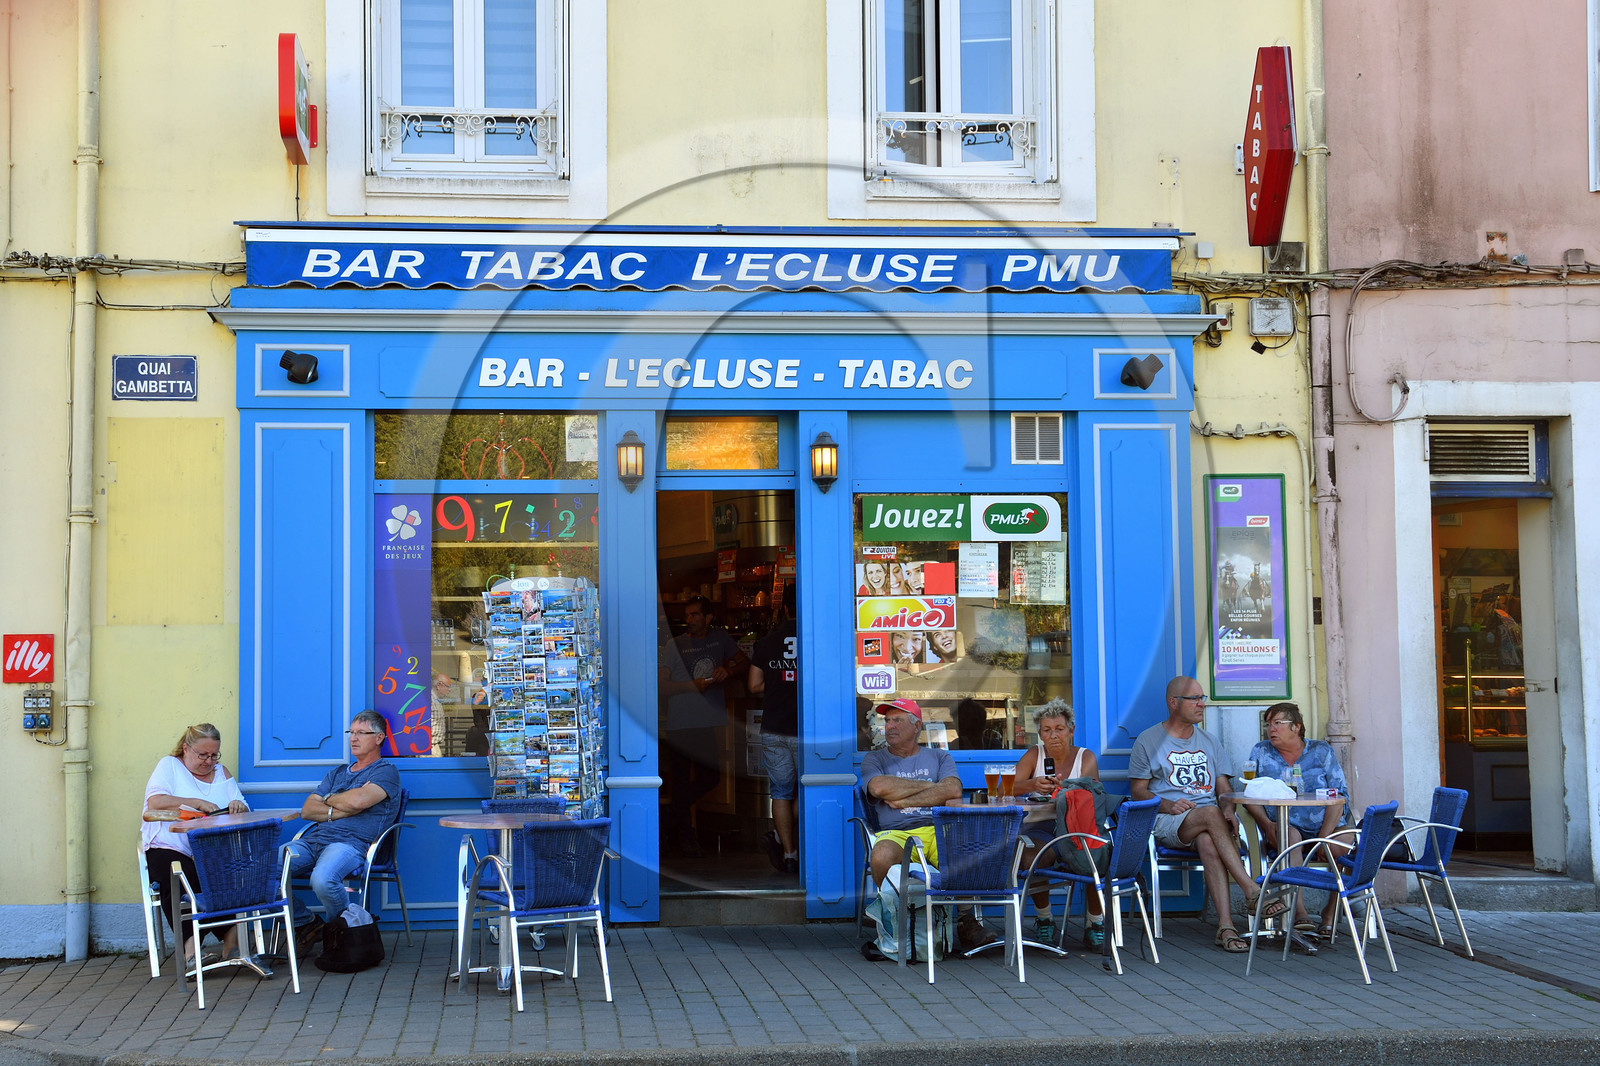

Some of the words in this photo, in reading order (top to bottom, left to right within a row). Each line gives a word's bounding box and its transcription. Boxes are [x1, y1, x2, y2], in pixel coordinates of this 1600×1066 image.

[1250, 84, 1262, 211] TABAC
[302, 249, 425, 279] BAR
[460, 251, 647, 281] TABAC
[691, 252, 957, 283] L'ECLUSE
[1001, 254, 1121, 283] PMU
[138, 362, 171, 375] QUAI
[479, 358, 564, 388] BAR
[605, 358, 800, 389] L'ECLUSE
[838, 359, 974, 389] TABAC
[116, 380, 193, 393] GAMBETTA
[494, 500, 513, 534] 7
[558, 510, 576, 538] 2
[869, 503, 965, 529] Jouez!
[990, 513, 1018, 525] PMU
[382, 545, 425, 553] FRANÇAISE
[5, 640, 51, 678] illy
[392, 645, 402, 658] 9
[1221, 645, 1232, 653] 10
[1233, 645, 1270, 653] MILLIONS
[407, 656, 419, 675] 2
[378, 666, 400, 695] 5
[398, 683, 427, 715] 7
[405, 706, 432, 754] 3
[1175, 755, 1196, 764] HAVE
[1176, 766, 1206, 787] 66
